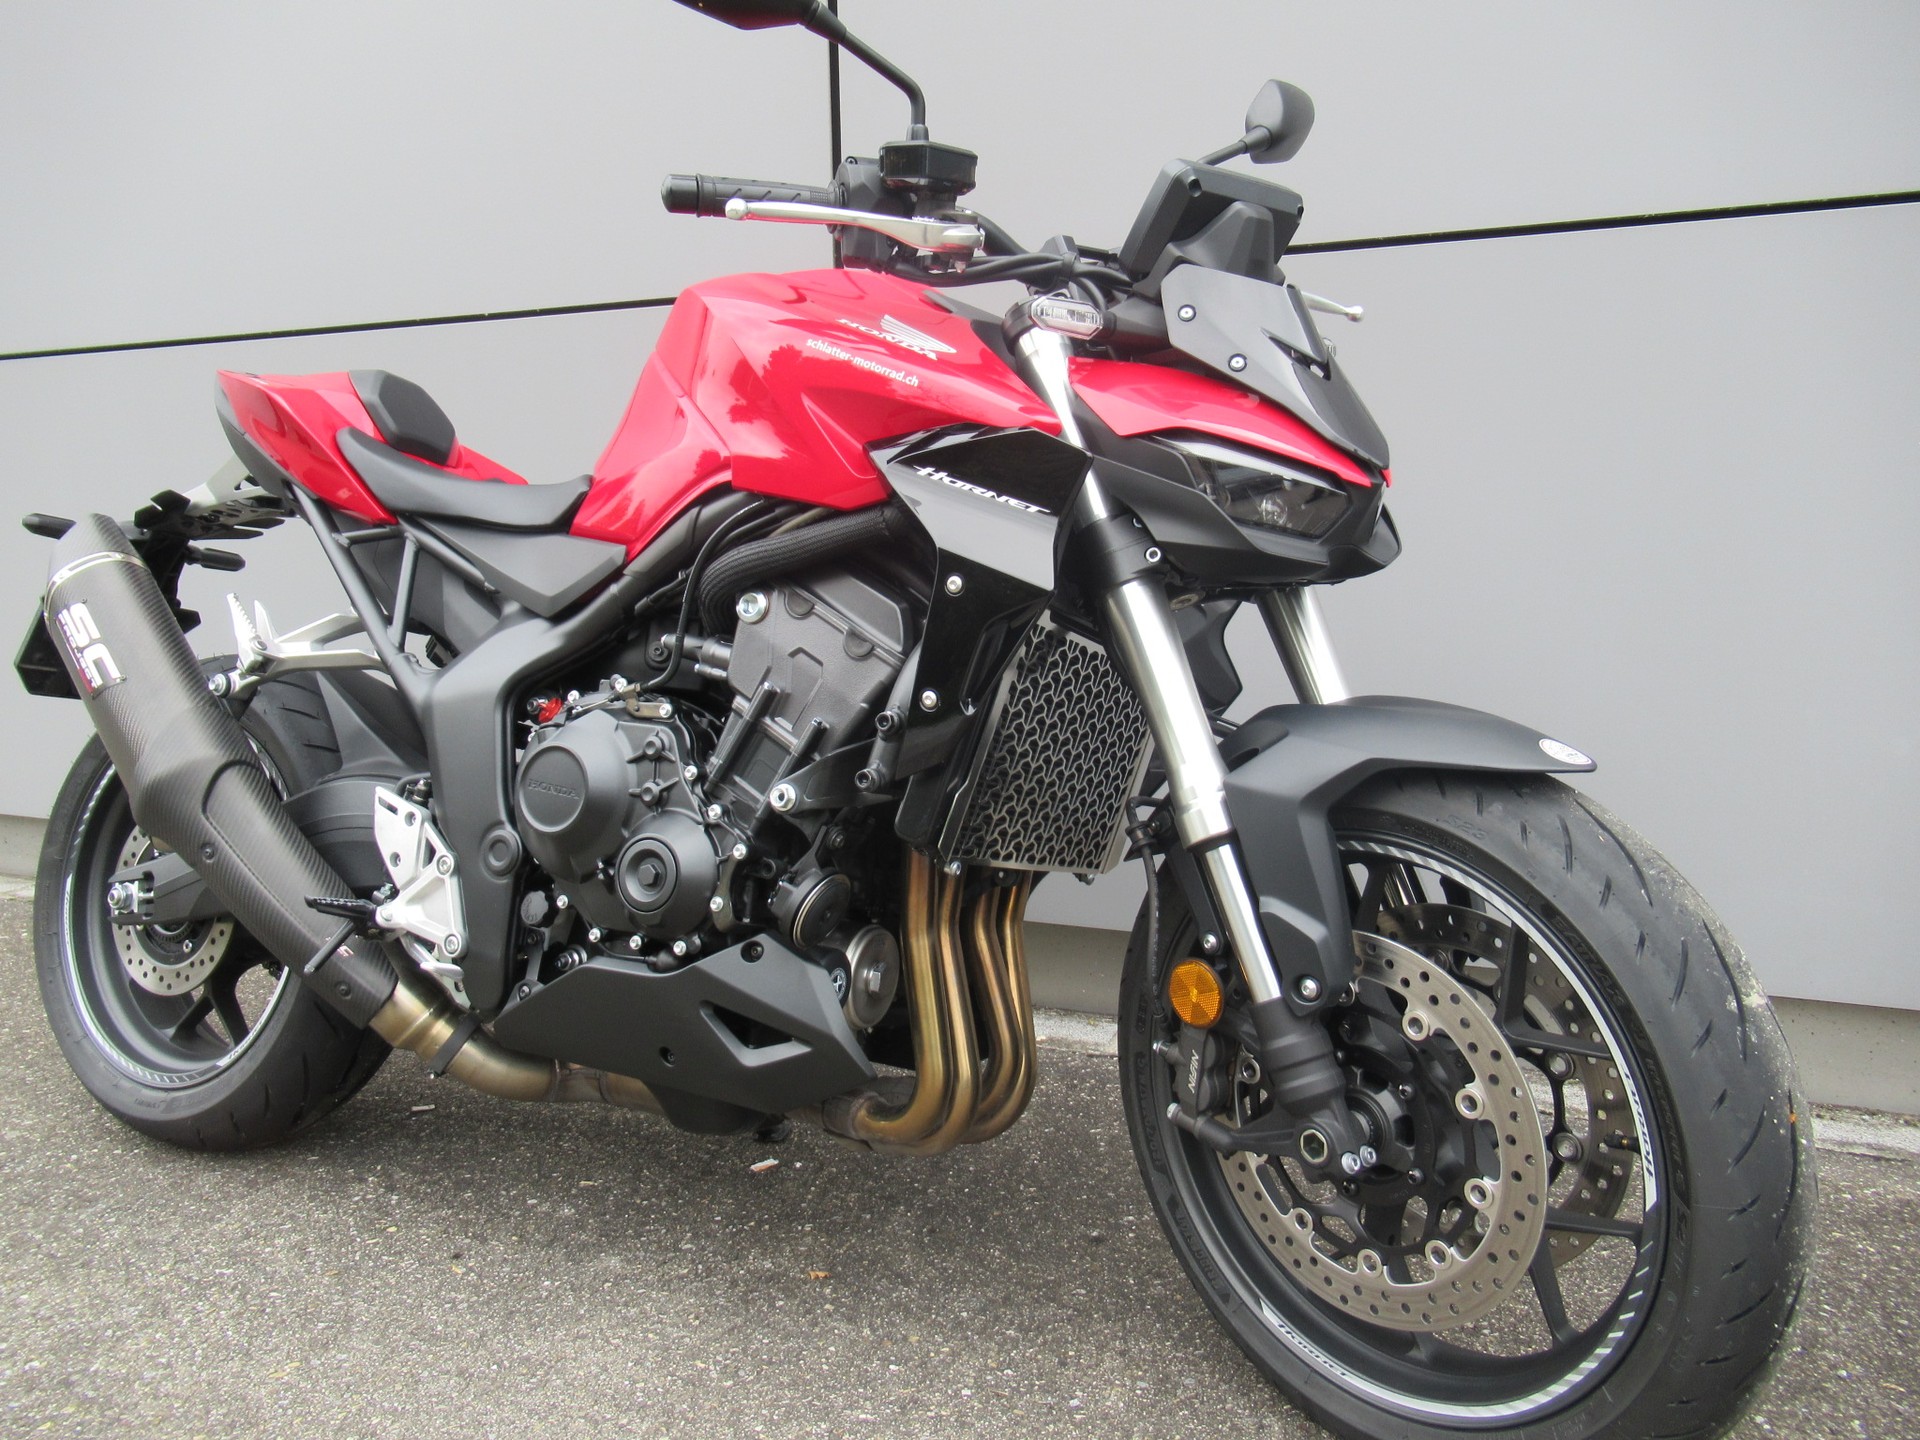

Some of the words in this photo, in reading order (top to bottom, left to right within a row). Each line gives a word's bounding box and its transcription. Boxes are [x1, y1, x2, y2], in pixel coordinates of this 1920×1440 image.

[806, 338, 919, 387] schlatter-motorrad.ch
[836, 318, 939, 361] HONDA
[913, 465, 1051, 513] HORNET
[61, 602, 121, 687] SC
[527, 779, 580, 800] HONDA
[1187, 1049, 1199, 1094] NISSIN
